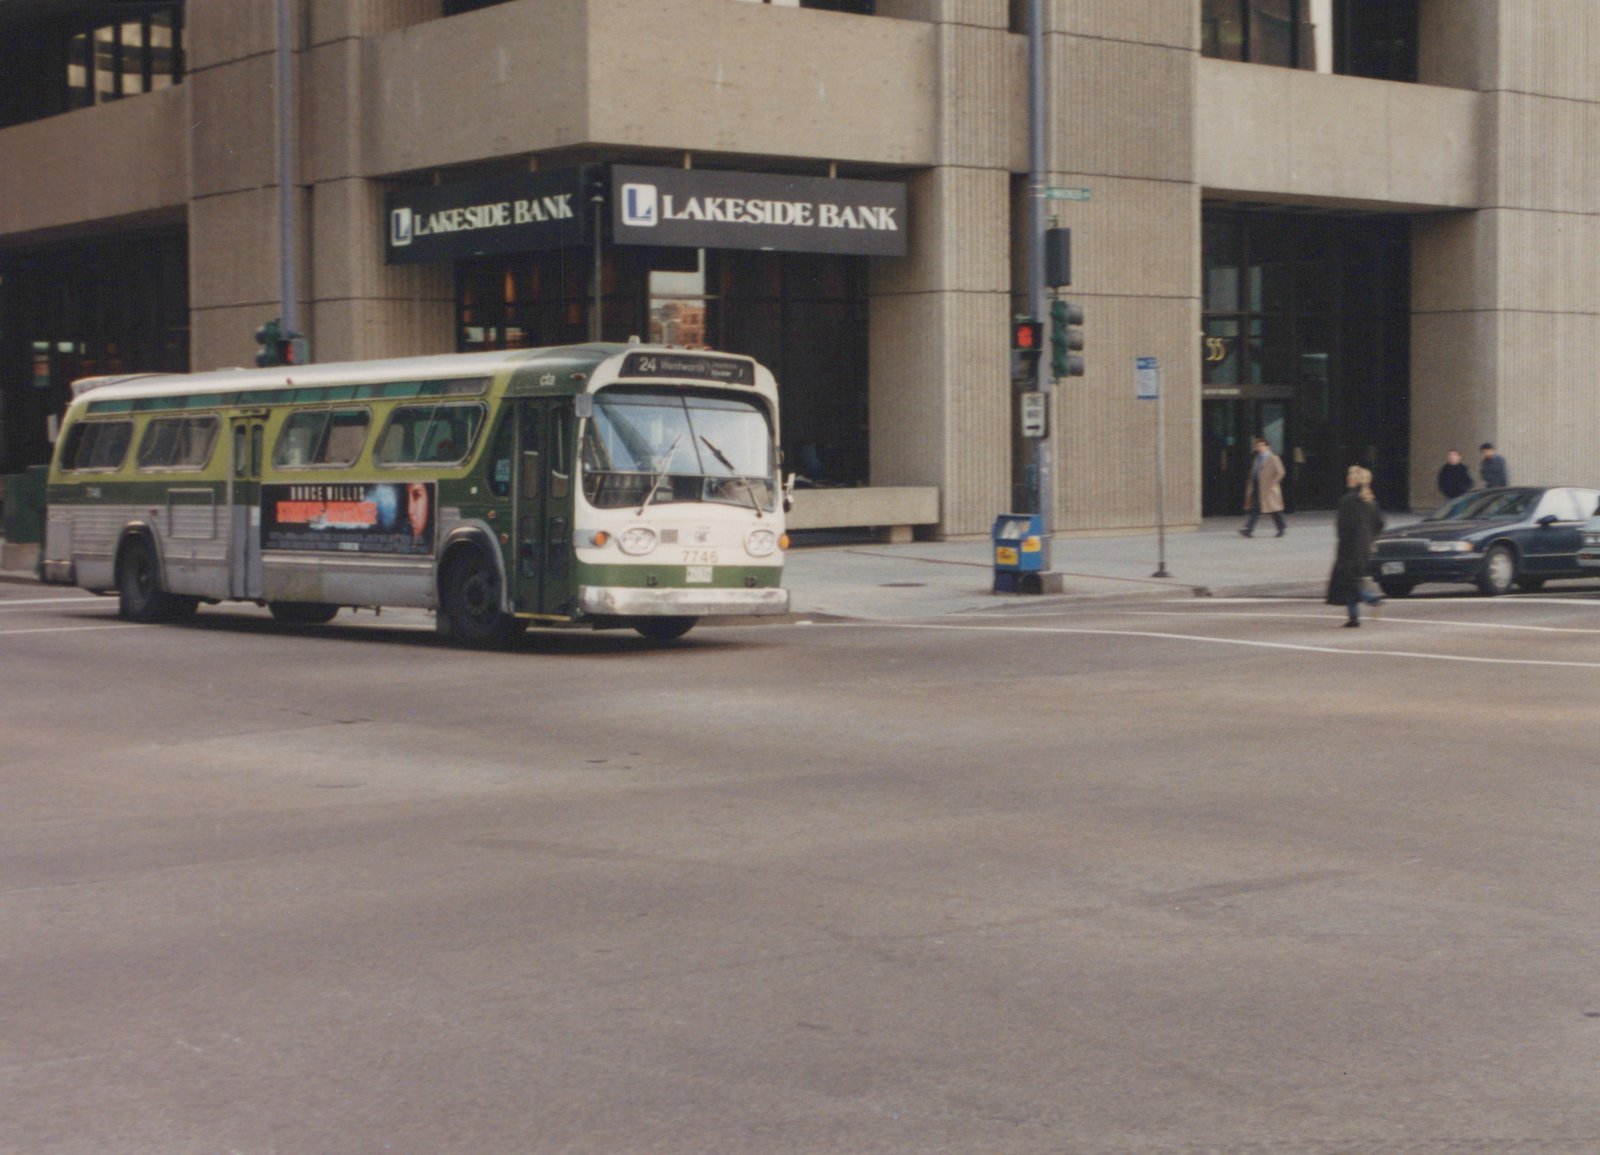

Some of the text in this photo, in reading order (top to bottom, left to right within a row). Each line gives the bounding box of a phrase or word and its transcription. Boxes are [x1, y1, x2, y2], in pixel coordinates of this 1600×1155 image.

[414, 202, 511, 236] LAKESIDE
[513, 194, 574, 224] BANK
[661, 195, 814, 227] LAKESIDE
[818, 204, 898, 231] BANK
[639, 357, 656, 372] 24
